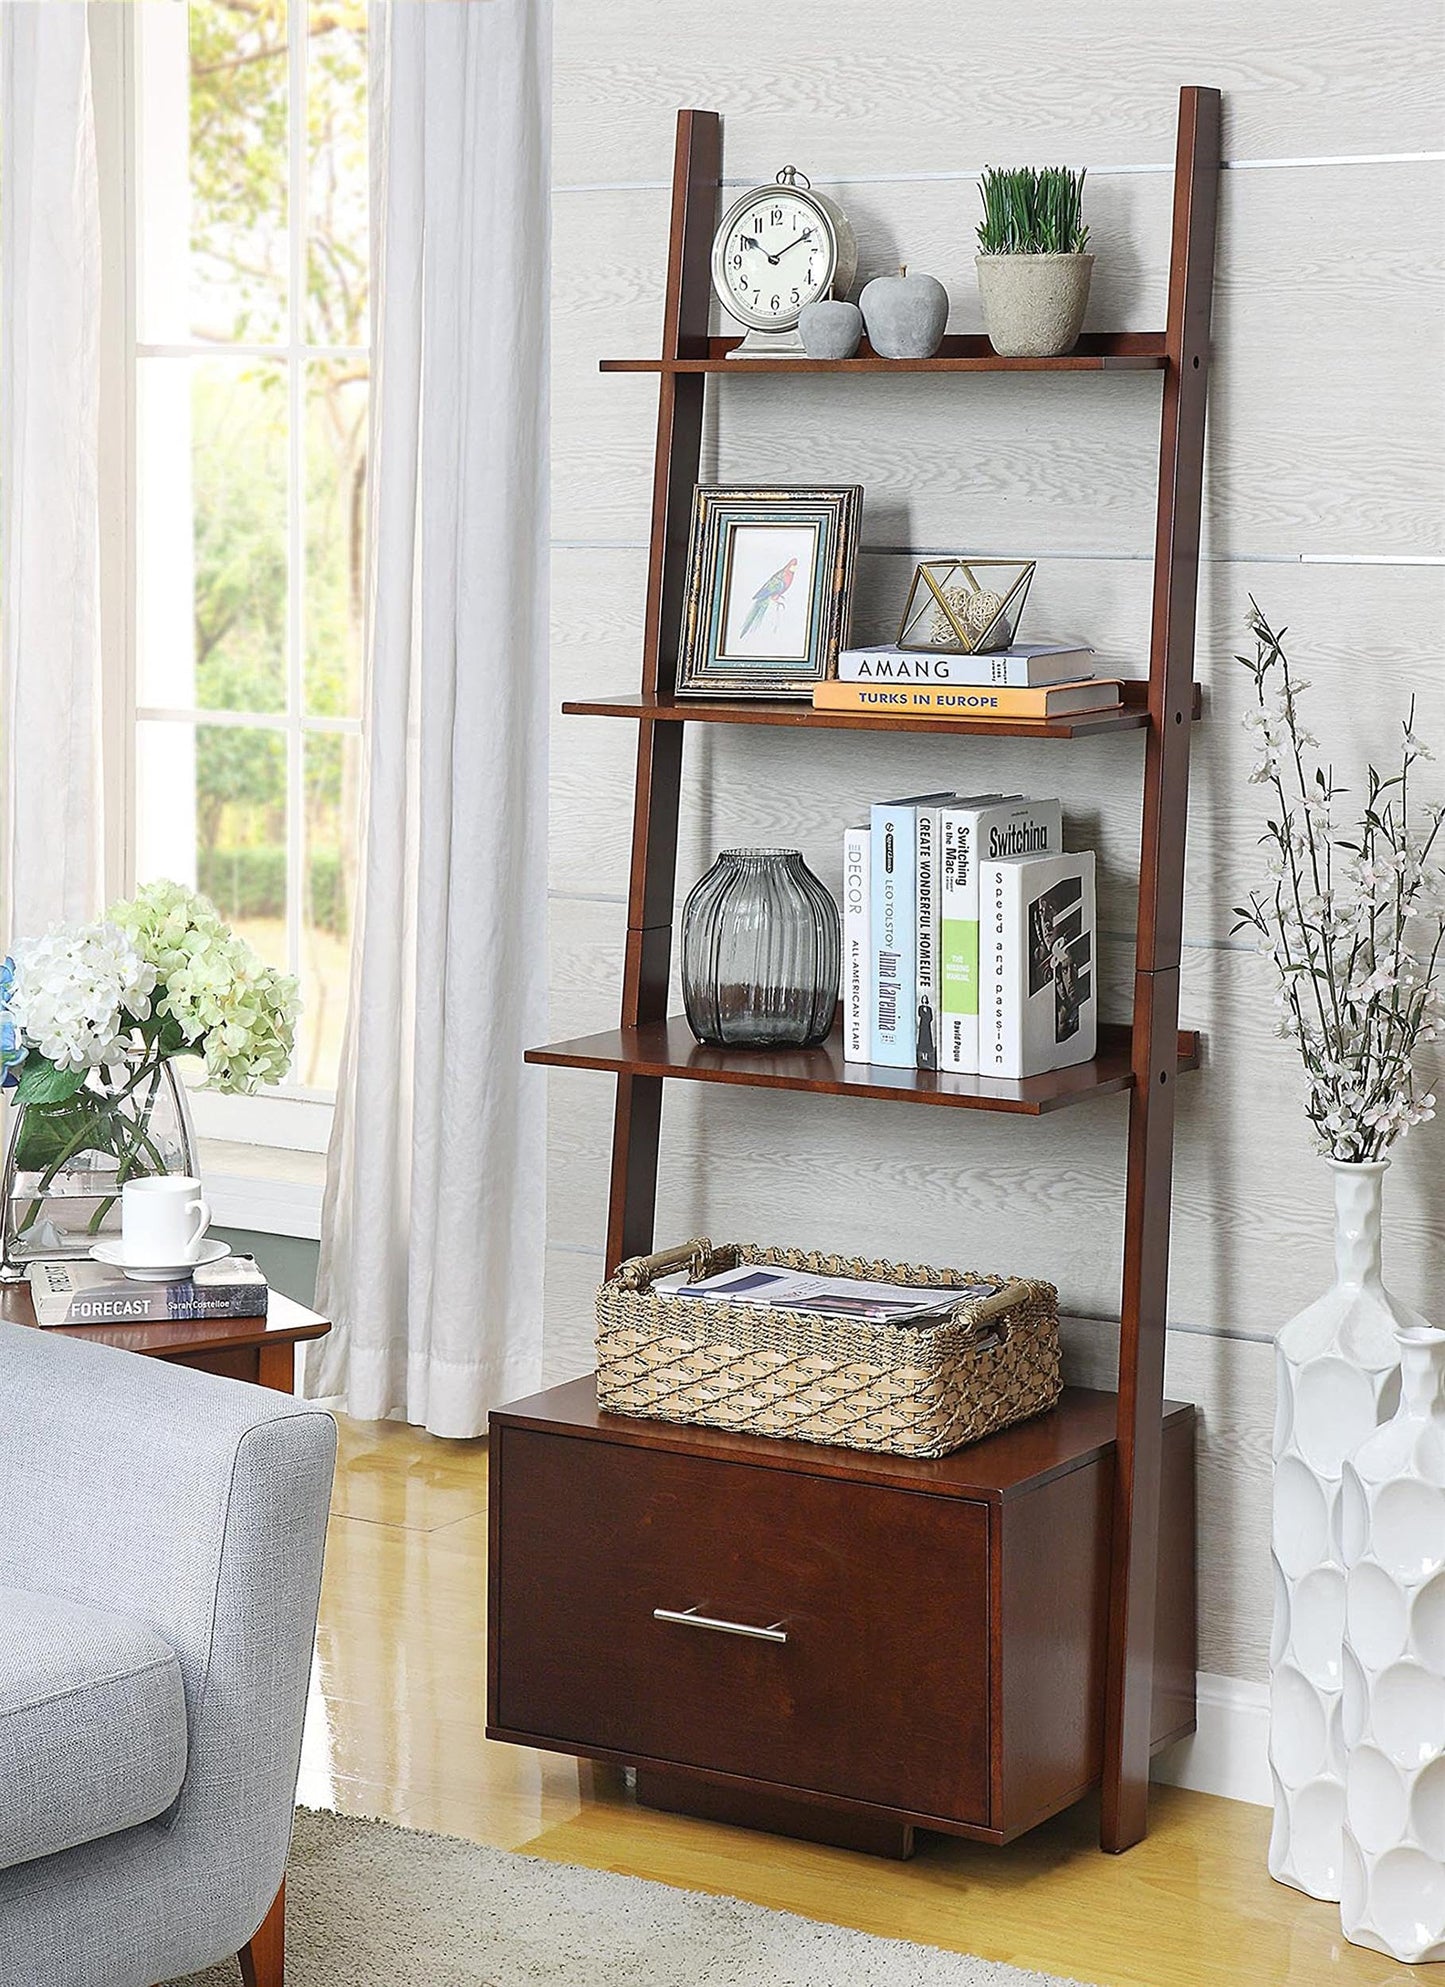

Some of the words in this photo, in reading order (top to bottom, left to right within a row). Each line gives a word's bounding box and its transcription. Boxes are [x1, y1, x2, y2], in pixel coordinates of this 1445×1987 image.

[754, 217, 763, 233] 11
[771, 210, 783, 226] 12
[733, 254, 742, 270] 9
[739, 274, 748, 291] 8
[753, 289, 761, 305] 7
[771, 294, 780, 310] 6
[790, 287, 800, 304] 5
[857, 660, 950, 678] AMANG
[859, 692, 908, 704] TURKS
[913, 694, 930, 705] IN
[936, 695, 998, 707] EUROPE
[945, 821, 953, 830] to
[920, 817, 931, 857] CREATE
[945, 832, 953, 845] the
[990, 820, 1047, 858] Switching
[945, 847, 957, 874] Mac
[955, 826, 970, 886] Switching
[885, 880, 894, 900] LEO
[920, 861, 931, 929] WONDERFUL
[995, 872, 1003, 933] Speed
[885, 902, 894, 949] TOLSTOY
[879, 950, 901, 978] Anna
[920, 932, 931, 987] HOMELIFE
[995, 942, 1003, 976] and
[852, 940, 860, 1018] ALL-AMERICAN
[878, 981, 901, 1031] Karenina
[954, 1020, 962, 1040] David
[995, 984, 1003, 1064] passion
[852, 1021, 860, 1050] FLAIR
[71, 1299, 151, 1317] FORECAST
[167, 1300, 191, 1310] Sarah
[192, 1299, 230, 1310] Costelloe
